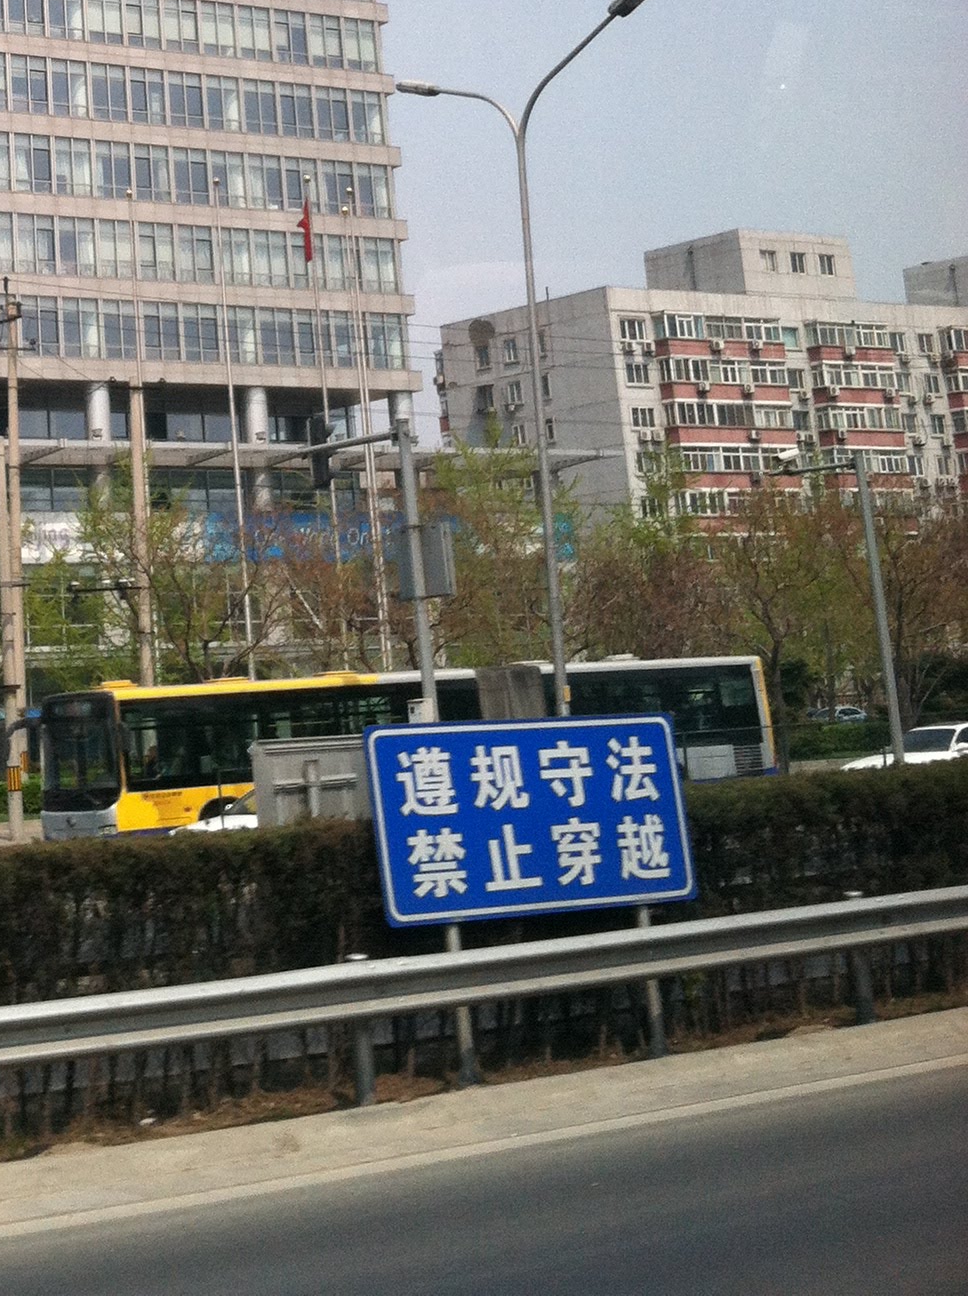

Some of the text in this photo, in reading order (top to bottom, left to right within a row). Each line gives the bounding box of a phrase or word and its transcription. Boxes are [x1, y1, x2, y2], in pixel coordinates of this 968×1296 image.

[395, 736, 660, 816] 遵规守法
[407, 813, 671, 898] 禁止穿越
